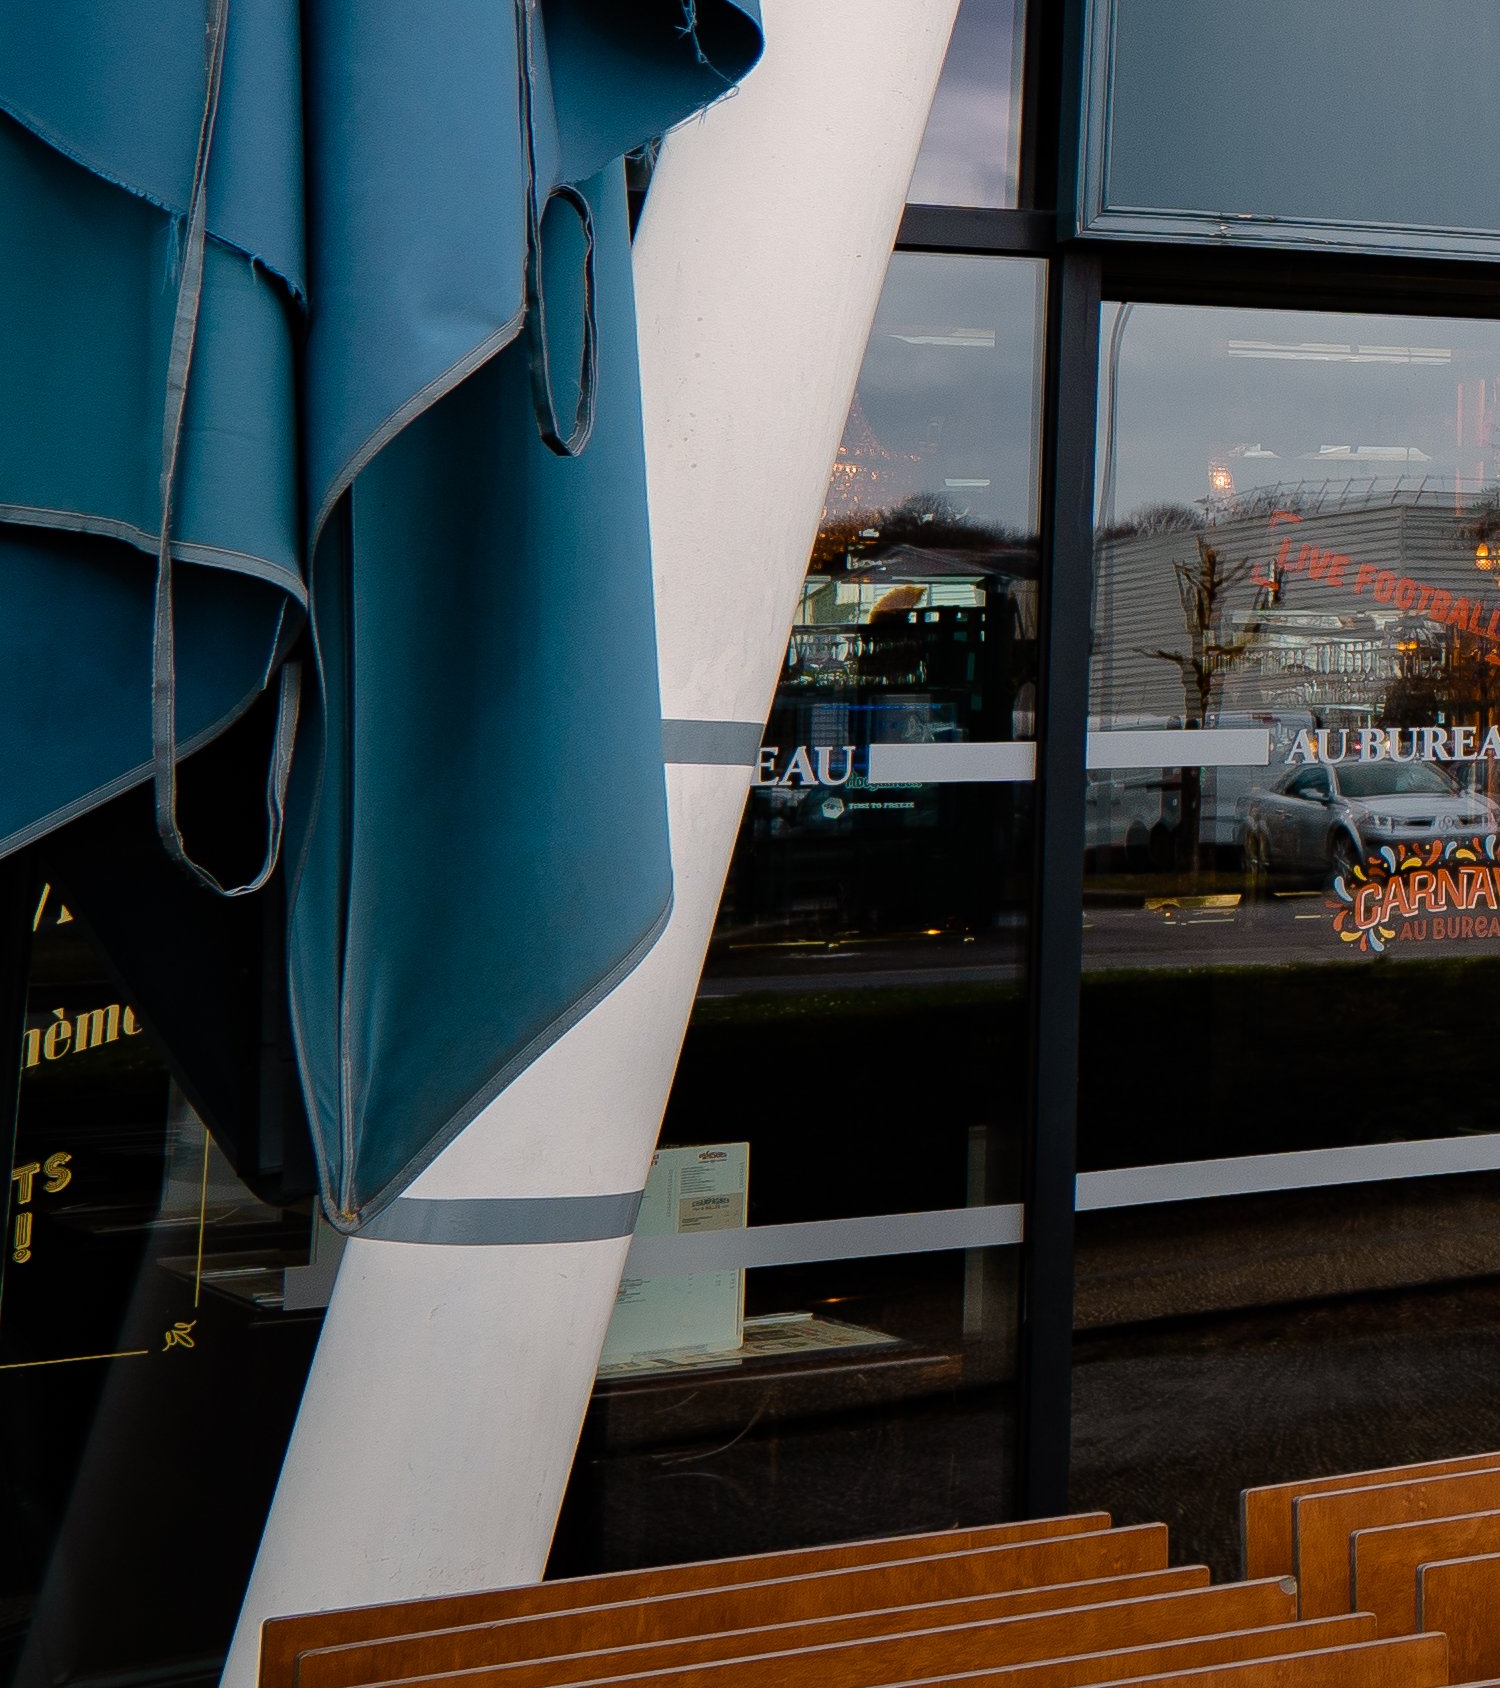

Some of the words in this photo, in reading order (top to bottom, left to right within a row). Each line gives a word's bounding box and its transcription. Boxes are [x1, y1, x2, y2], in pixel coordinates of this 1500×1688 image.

[1276, 537, 1350, 587] LIVE
[1284, 725, 1350, 764] AU
[1400, 917, 1428, 940] AU
